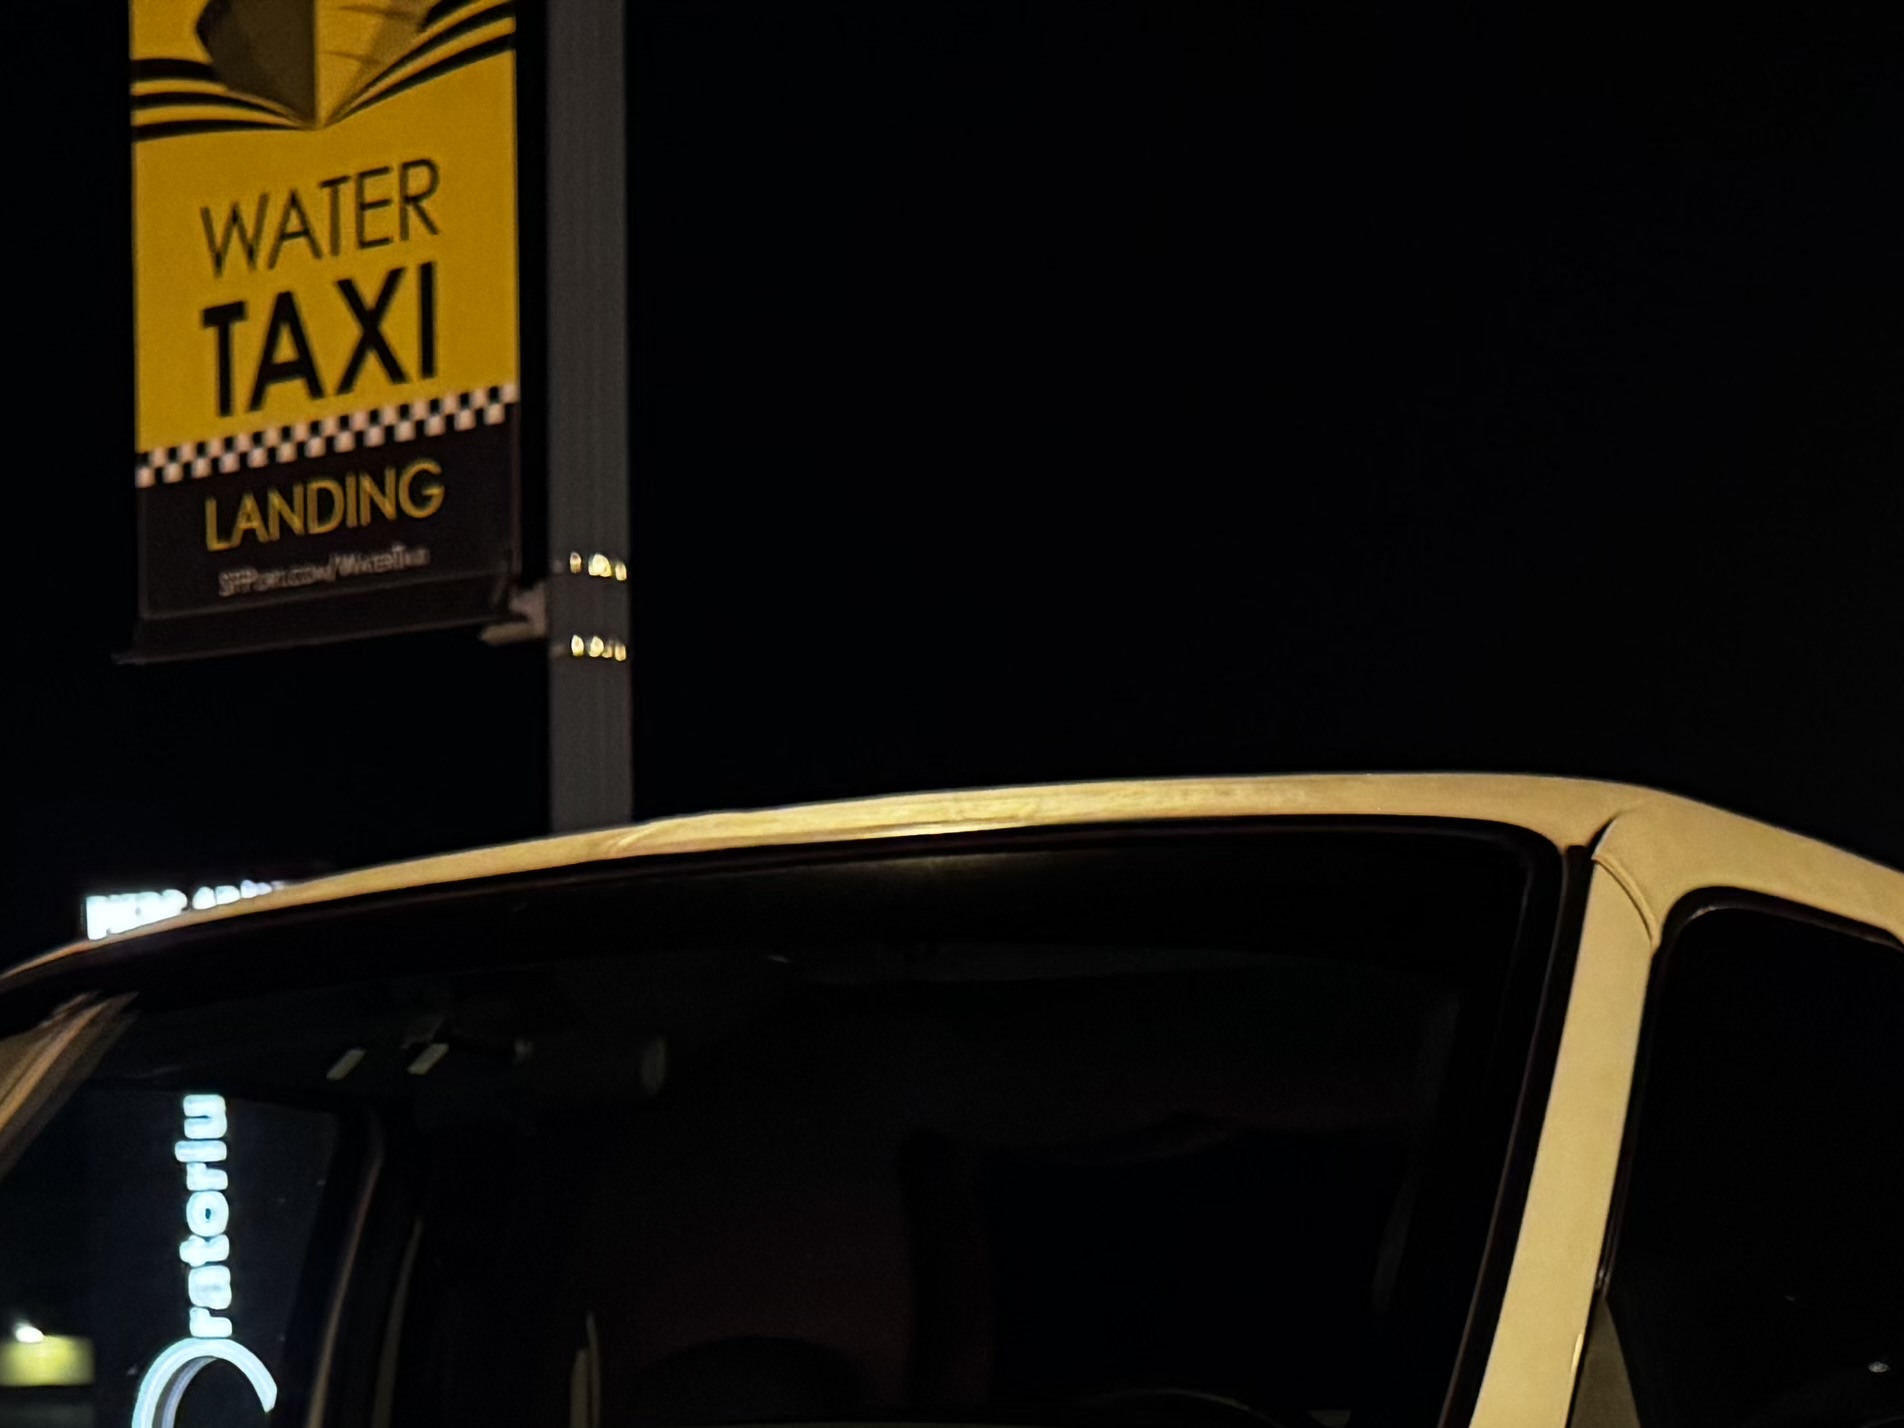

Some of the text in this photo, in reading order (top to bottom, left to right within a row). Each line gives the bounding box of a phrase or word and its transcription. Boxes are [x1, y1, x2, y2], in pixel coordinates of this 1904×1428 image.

[199, 157, 441, 279] WATER
[201, 261, 438, 418] TAXI
[204, 459, 446, 551] LANDING
